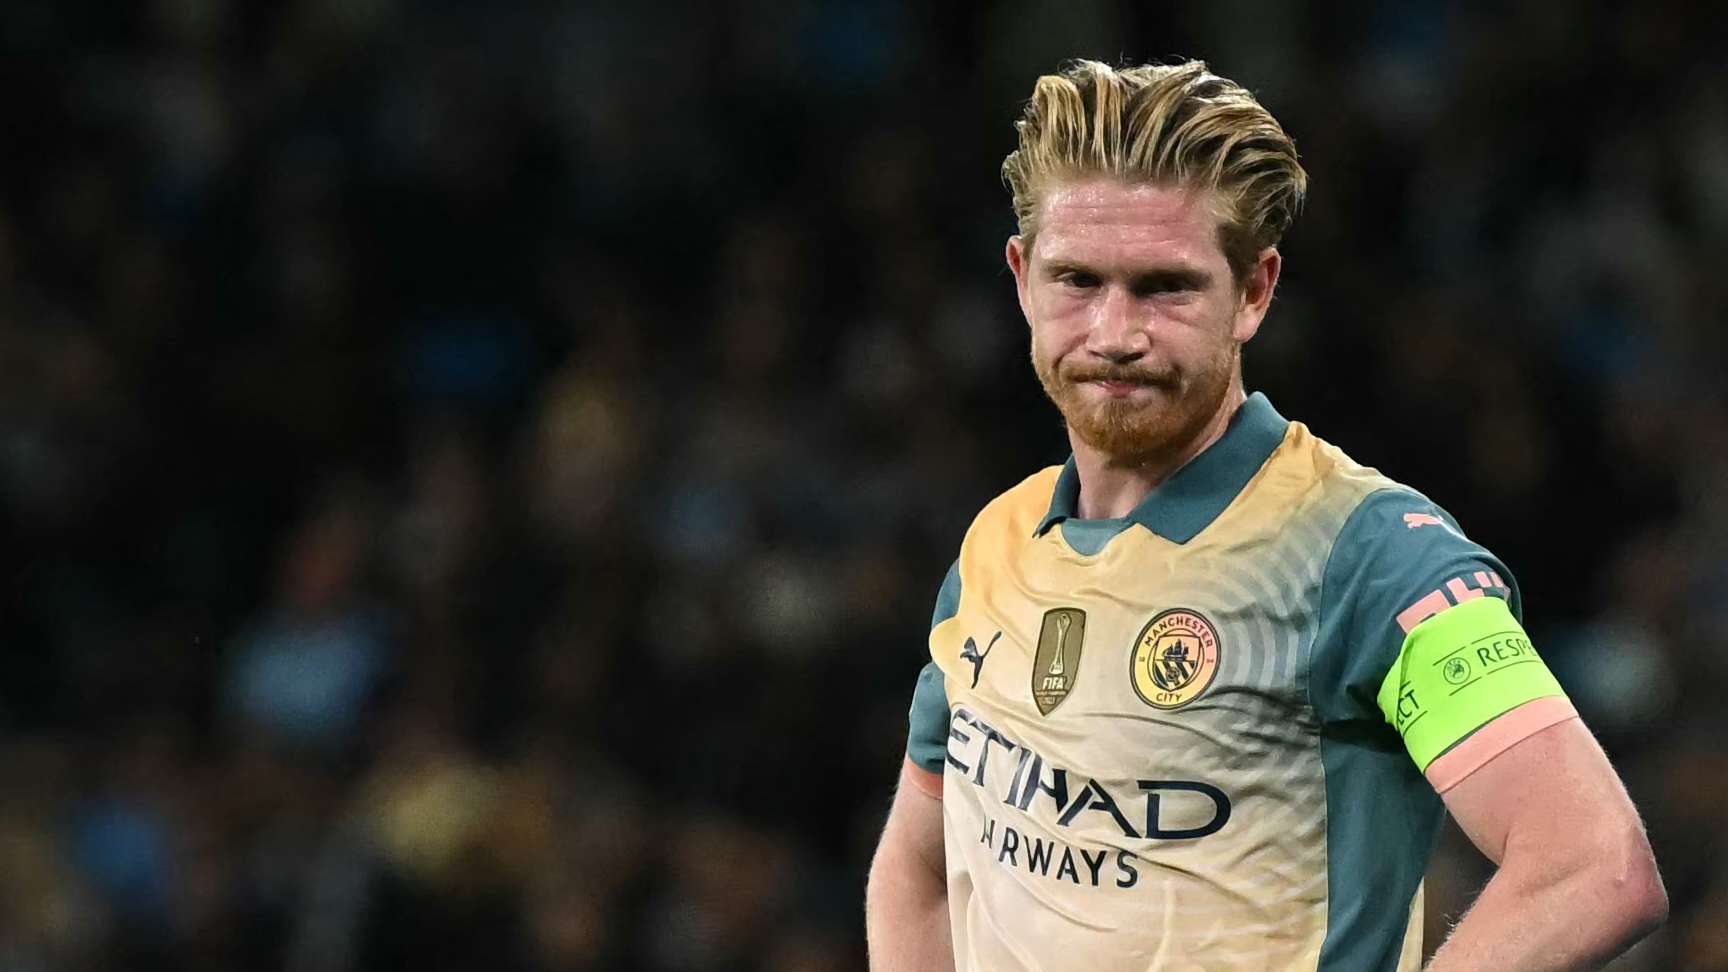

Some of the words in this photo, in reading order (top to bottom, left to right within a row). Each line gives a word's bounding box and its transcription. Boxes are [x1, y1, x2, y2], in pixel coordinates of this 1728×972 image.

[1144, 615, 1214, 648] MANCHESTER
[1042, 676, 1064, 690] FIFA
[1156, 692, 1183, 703] CITY
[1397, 688, 1420, 726] CT
[945, 708, 1232, 840] ETIHAD
